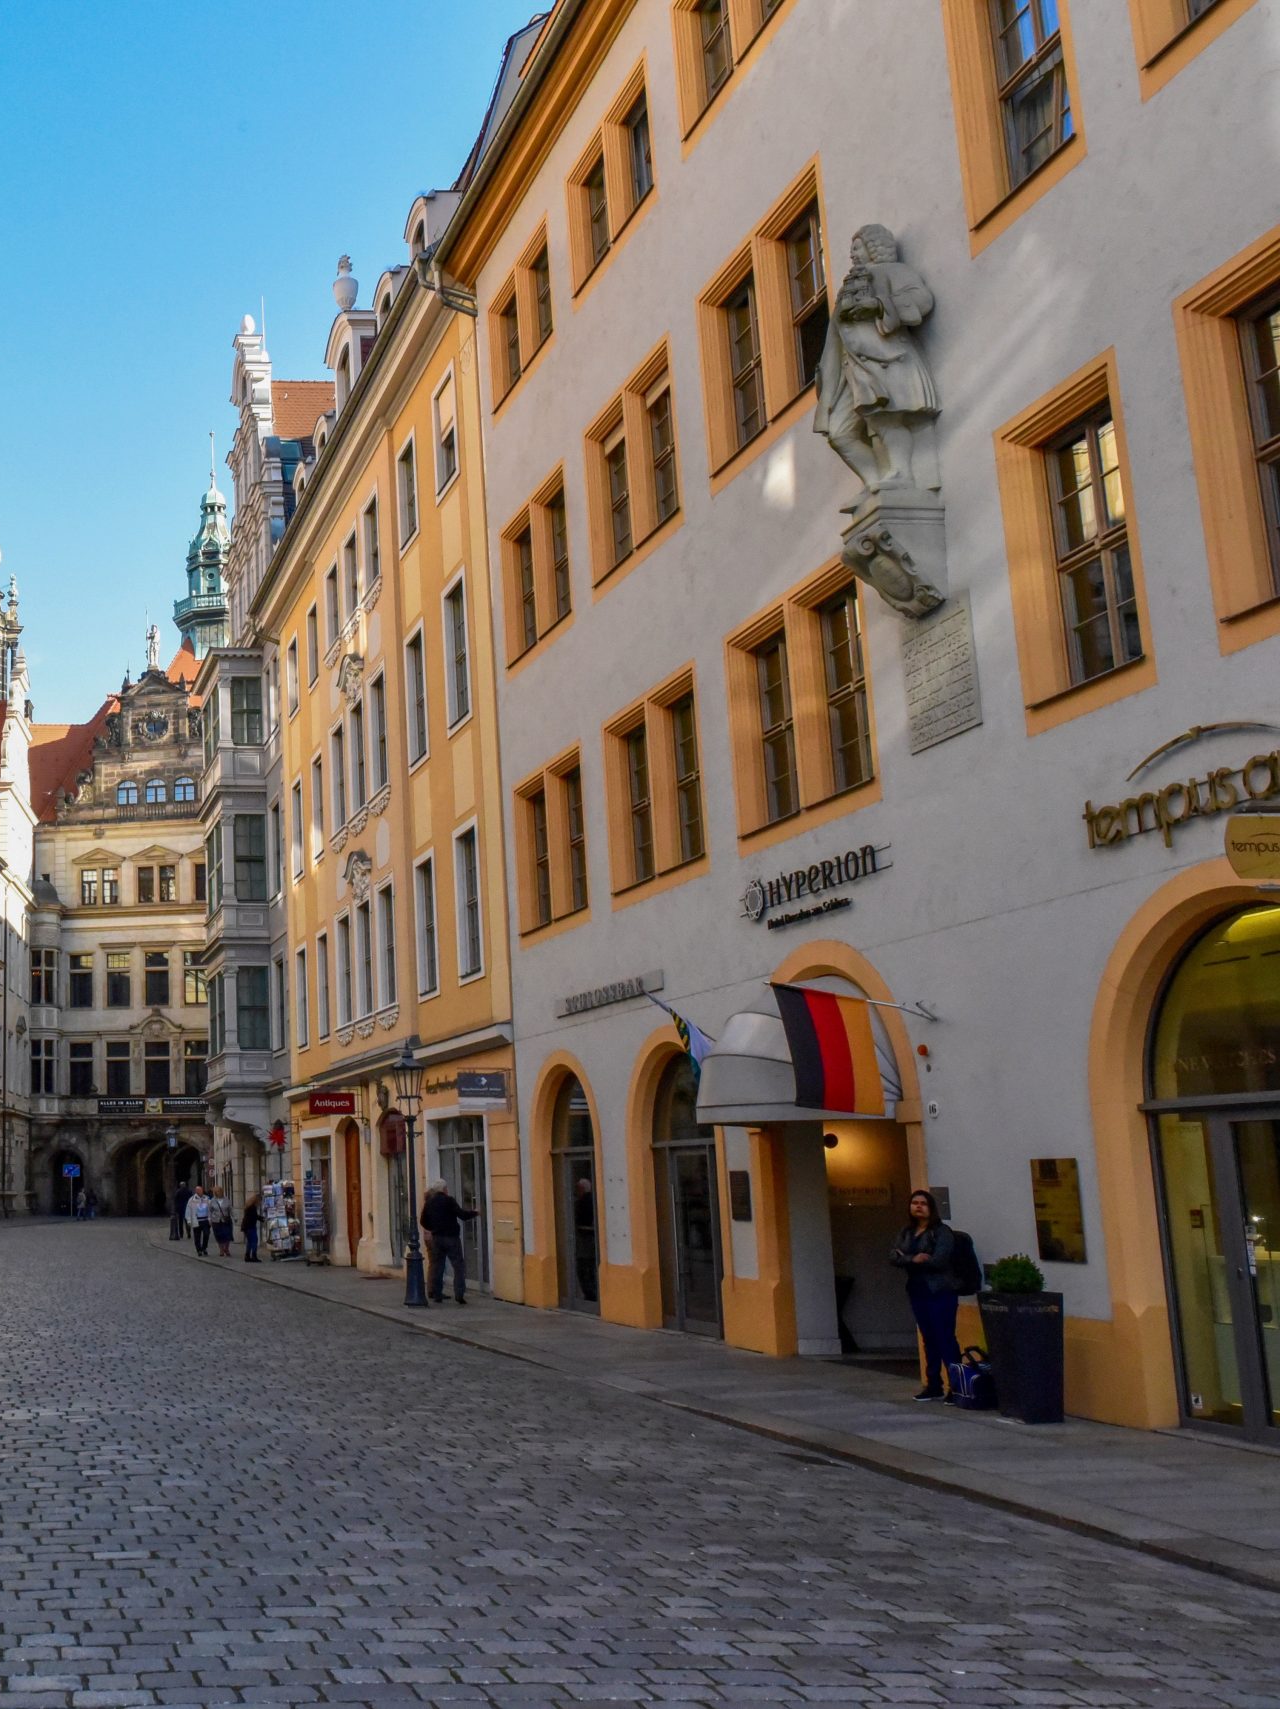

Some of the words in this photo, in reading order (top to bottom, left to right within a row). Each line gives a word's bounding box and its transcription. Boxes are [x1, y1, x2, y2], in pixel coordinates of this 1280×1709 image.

[767, 914, 786, 930] Hotel
[784, 908, 812, 924] Dresden
[314, 1099, 351, 1108] Antiques
[928, 1103, 937, 1114] 16
